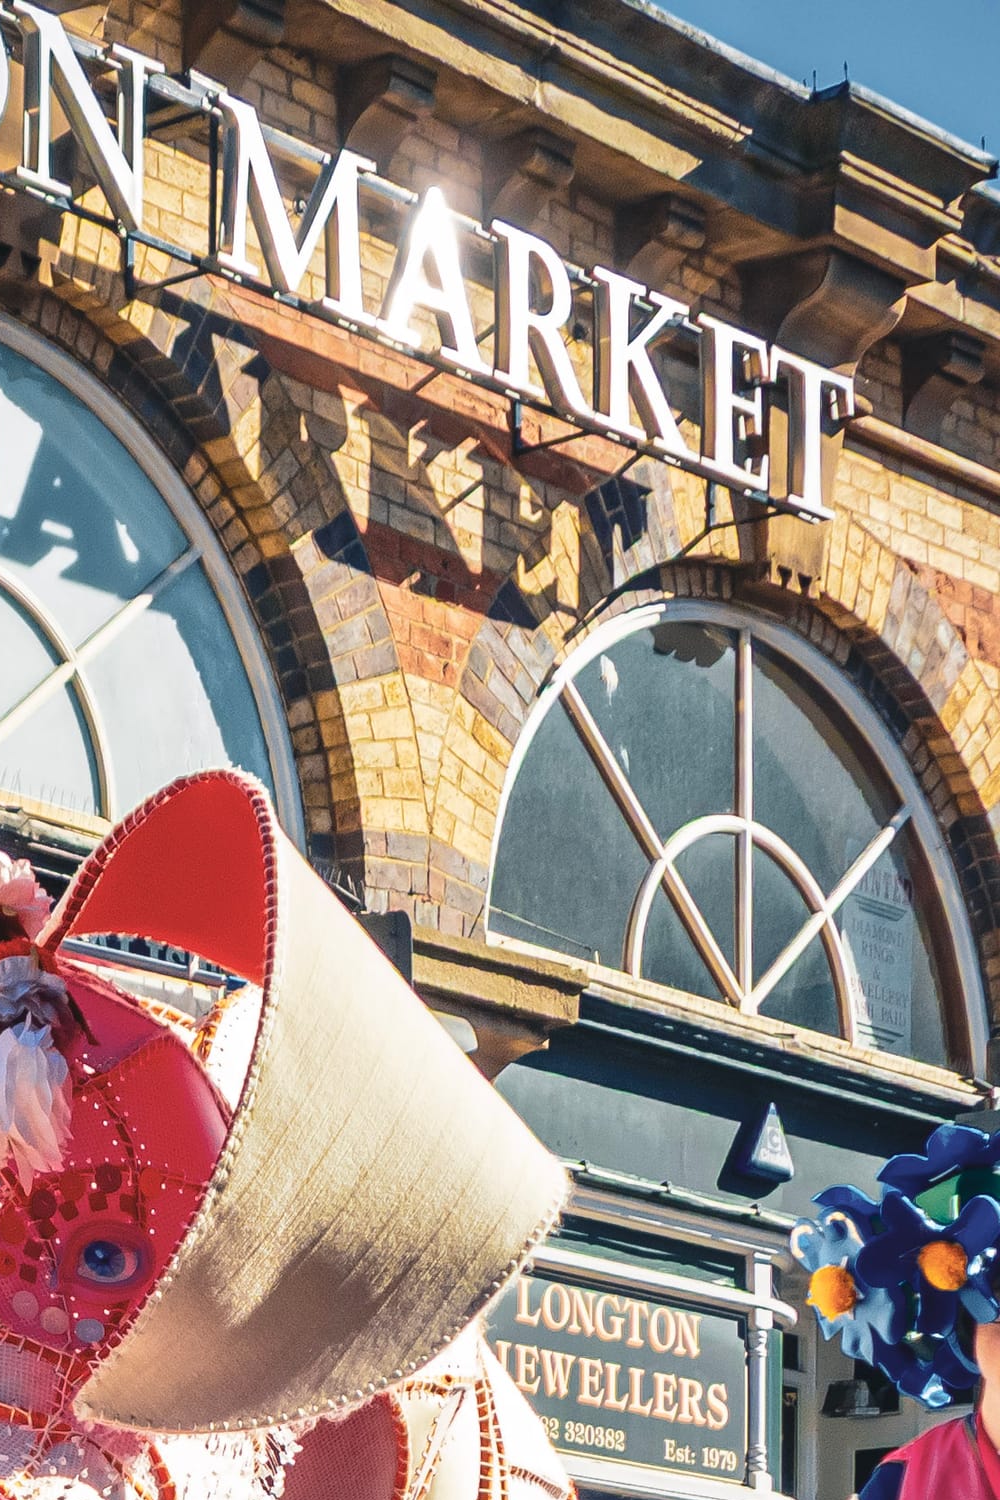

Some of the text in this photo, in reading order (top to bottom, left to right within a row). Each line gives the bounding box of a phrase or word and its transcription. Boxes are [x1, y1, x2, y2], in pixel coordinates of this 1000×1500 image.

[190, 69, 855, 523] MARKET
[515, 1277, 702, 1360] LONGTON
[564, 1420, 625, 1452] 320382
[663, 1438, 696, 1465] Est:
[702, 1447, 738, 1472] 1979
